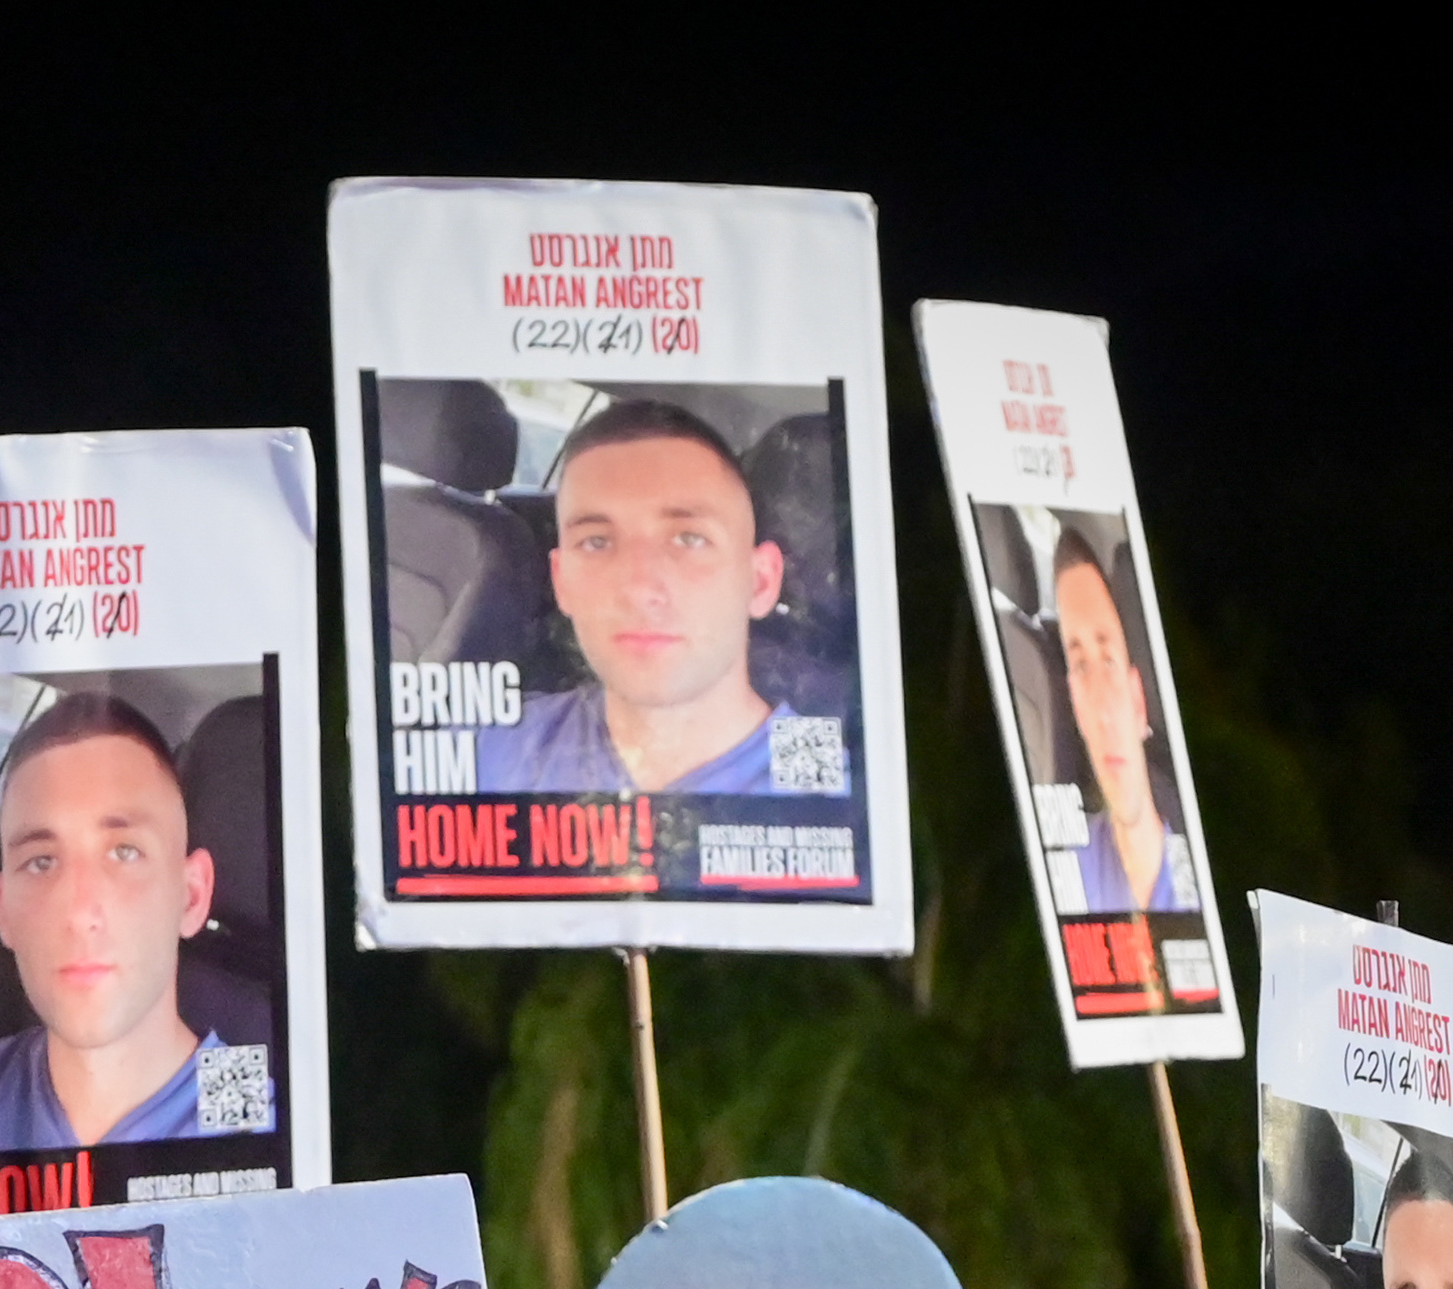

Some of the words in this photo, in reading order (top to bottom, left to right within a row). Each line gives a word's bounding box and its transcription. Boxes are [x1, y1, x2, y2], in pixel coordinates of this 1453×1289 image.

[529, 233, 621, 268] אנגרסט
[630, 235, 673, 272] מתן
[503, 274, 587, 308] MATAN
[595, 275, 704, 311] ANGREST
[73, 498, 116, 543] מתן
[43, 545, 146, 588] ANGREST
[391, 661, 521, 726] BRING
[394, 729, 477, 795] HIM
[397, 803, 519, 868] HOME
[531, 796, 654, 867] NOW!
[700, 847, 785, 877] FAMILIES
[789, 849, 855, 878] FORUM
[1353, 944, 1408, 996] אנגרסט
[1408, 959, 1432, 1004] מתן
[1338, 988, 1390, 1038] MATAN
[1395, 1001, 1451, 1055] ANGREST
